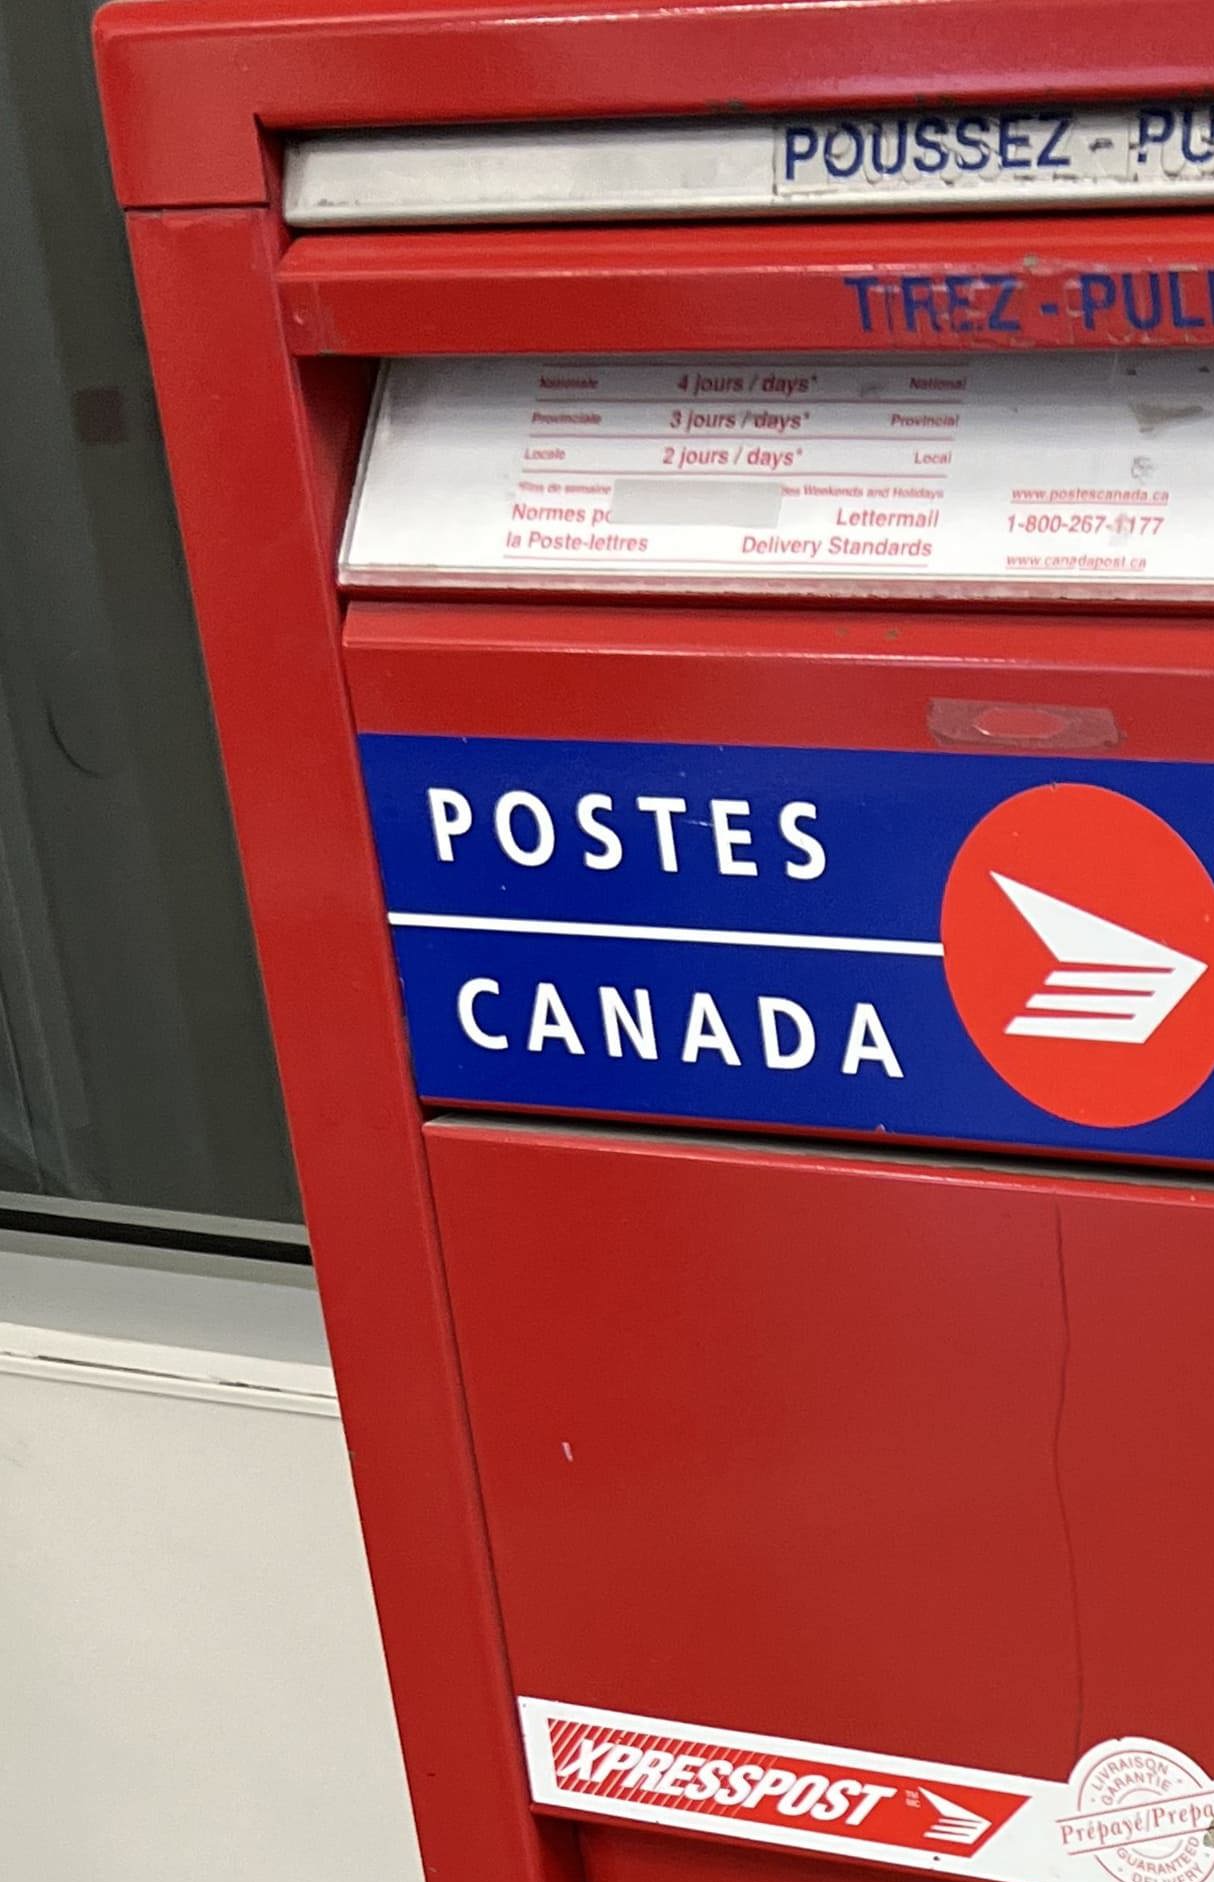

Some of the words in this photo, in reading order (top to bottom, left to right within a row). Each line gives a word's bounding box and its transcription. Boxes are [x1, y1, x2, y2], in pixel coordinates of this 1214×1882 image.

[785, 111, 1074, 181] POUSSEZ
[843, 272, 1023, 333] TIREZ
[677, 375, 689, 391] 4
[693, 374, 744, 396] jours
[909, 376, 968, 391] National
[670, 409, 682, 429] 3
[685, 410, 737, 433] jours
[889, 412, 961, 428] Provincial
[523, 447, 567, 462] Locale
[662, 446, 675, 466] 2
[678, 446, 729, 469] jours
[913, 450, 953, 466] Local
[803, 484, 864, 498] Weekends
[866, 486, 890, 499] and
[892, 486, 945, 501] Holidays
[1010, 486, 1170, 503] www.postescanada.ca
[510, 503, 586, 524] Normes
[591, 507, 613, 528] po
[835, 507, 941, 529] Lettermail
[1006, 513, 1166, 536] 1-800-267-1177
[505, 530, 522, 549] la
[527, 530, 650, 553] Poste-lettres
[741, 535, 823, 558] Delivery
[828, 535, 933, 558] Standards
[1005, 553, 1148, 571] www.canadapost.ca
[426, 786, 829, 881] POSTES
[456, 976, 906, 1079] CANADA
[560, 1738, 899, 1827] XPRESSPOST
[1090, 1755, 1170, 1792] LIVRAISON
[1100, 1770, 1174, 1807] GARANTIE
[1115, 1835, 1201, 1876] GUARANTEED
